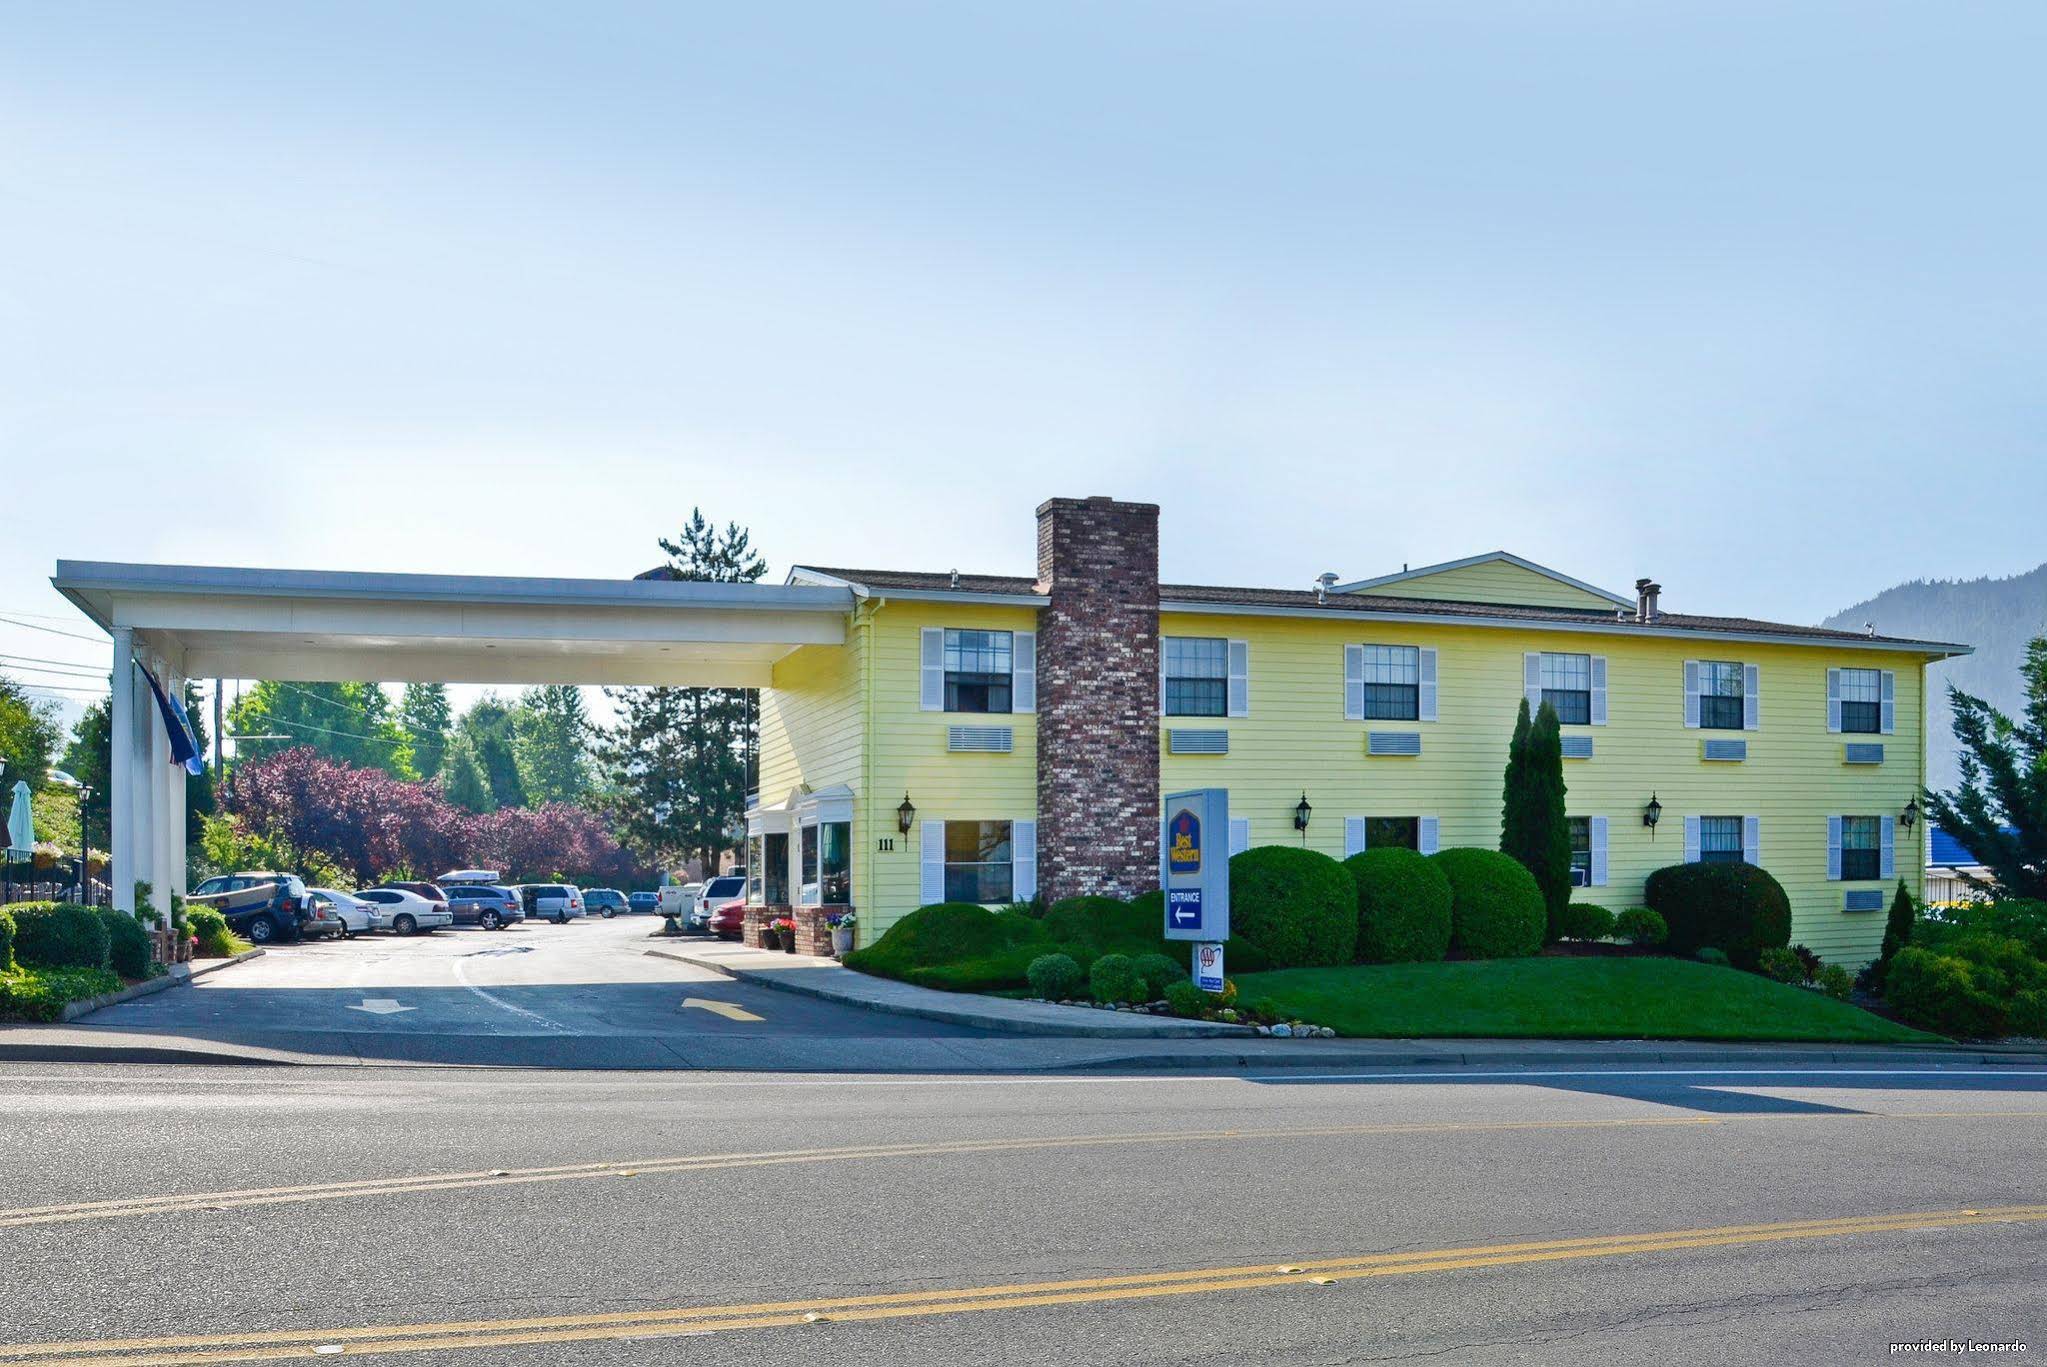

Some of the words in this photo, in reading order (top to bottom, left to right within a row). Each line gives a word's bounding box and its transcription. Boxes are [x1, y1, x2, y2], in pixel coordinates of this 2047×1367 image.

[879, 838, 894, 851] 111
[1175, 833, 1191, 848] Best
[1171, 848, 1199, 862] Western
[1170, 892, 1199, 902] ENTRANCE
